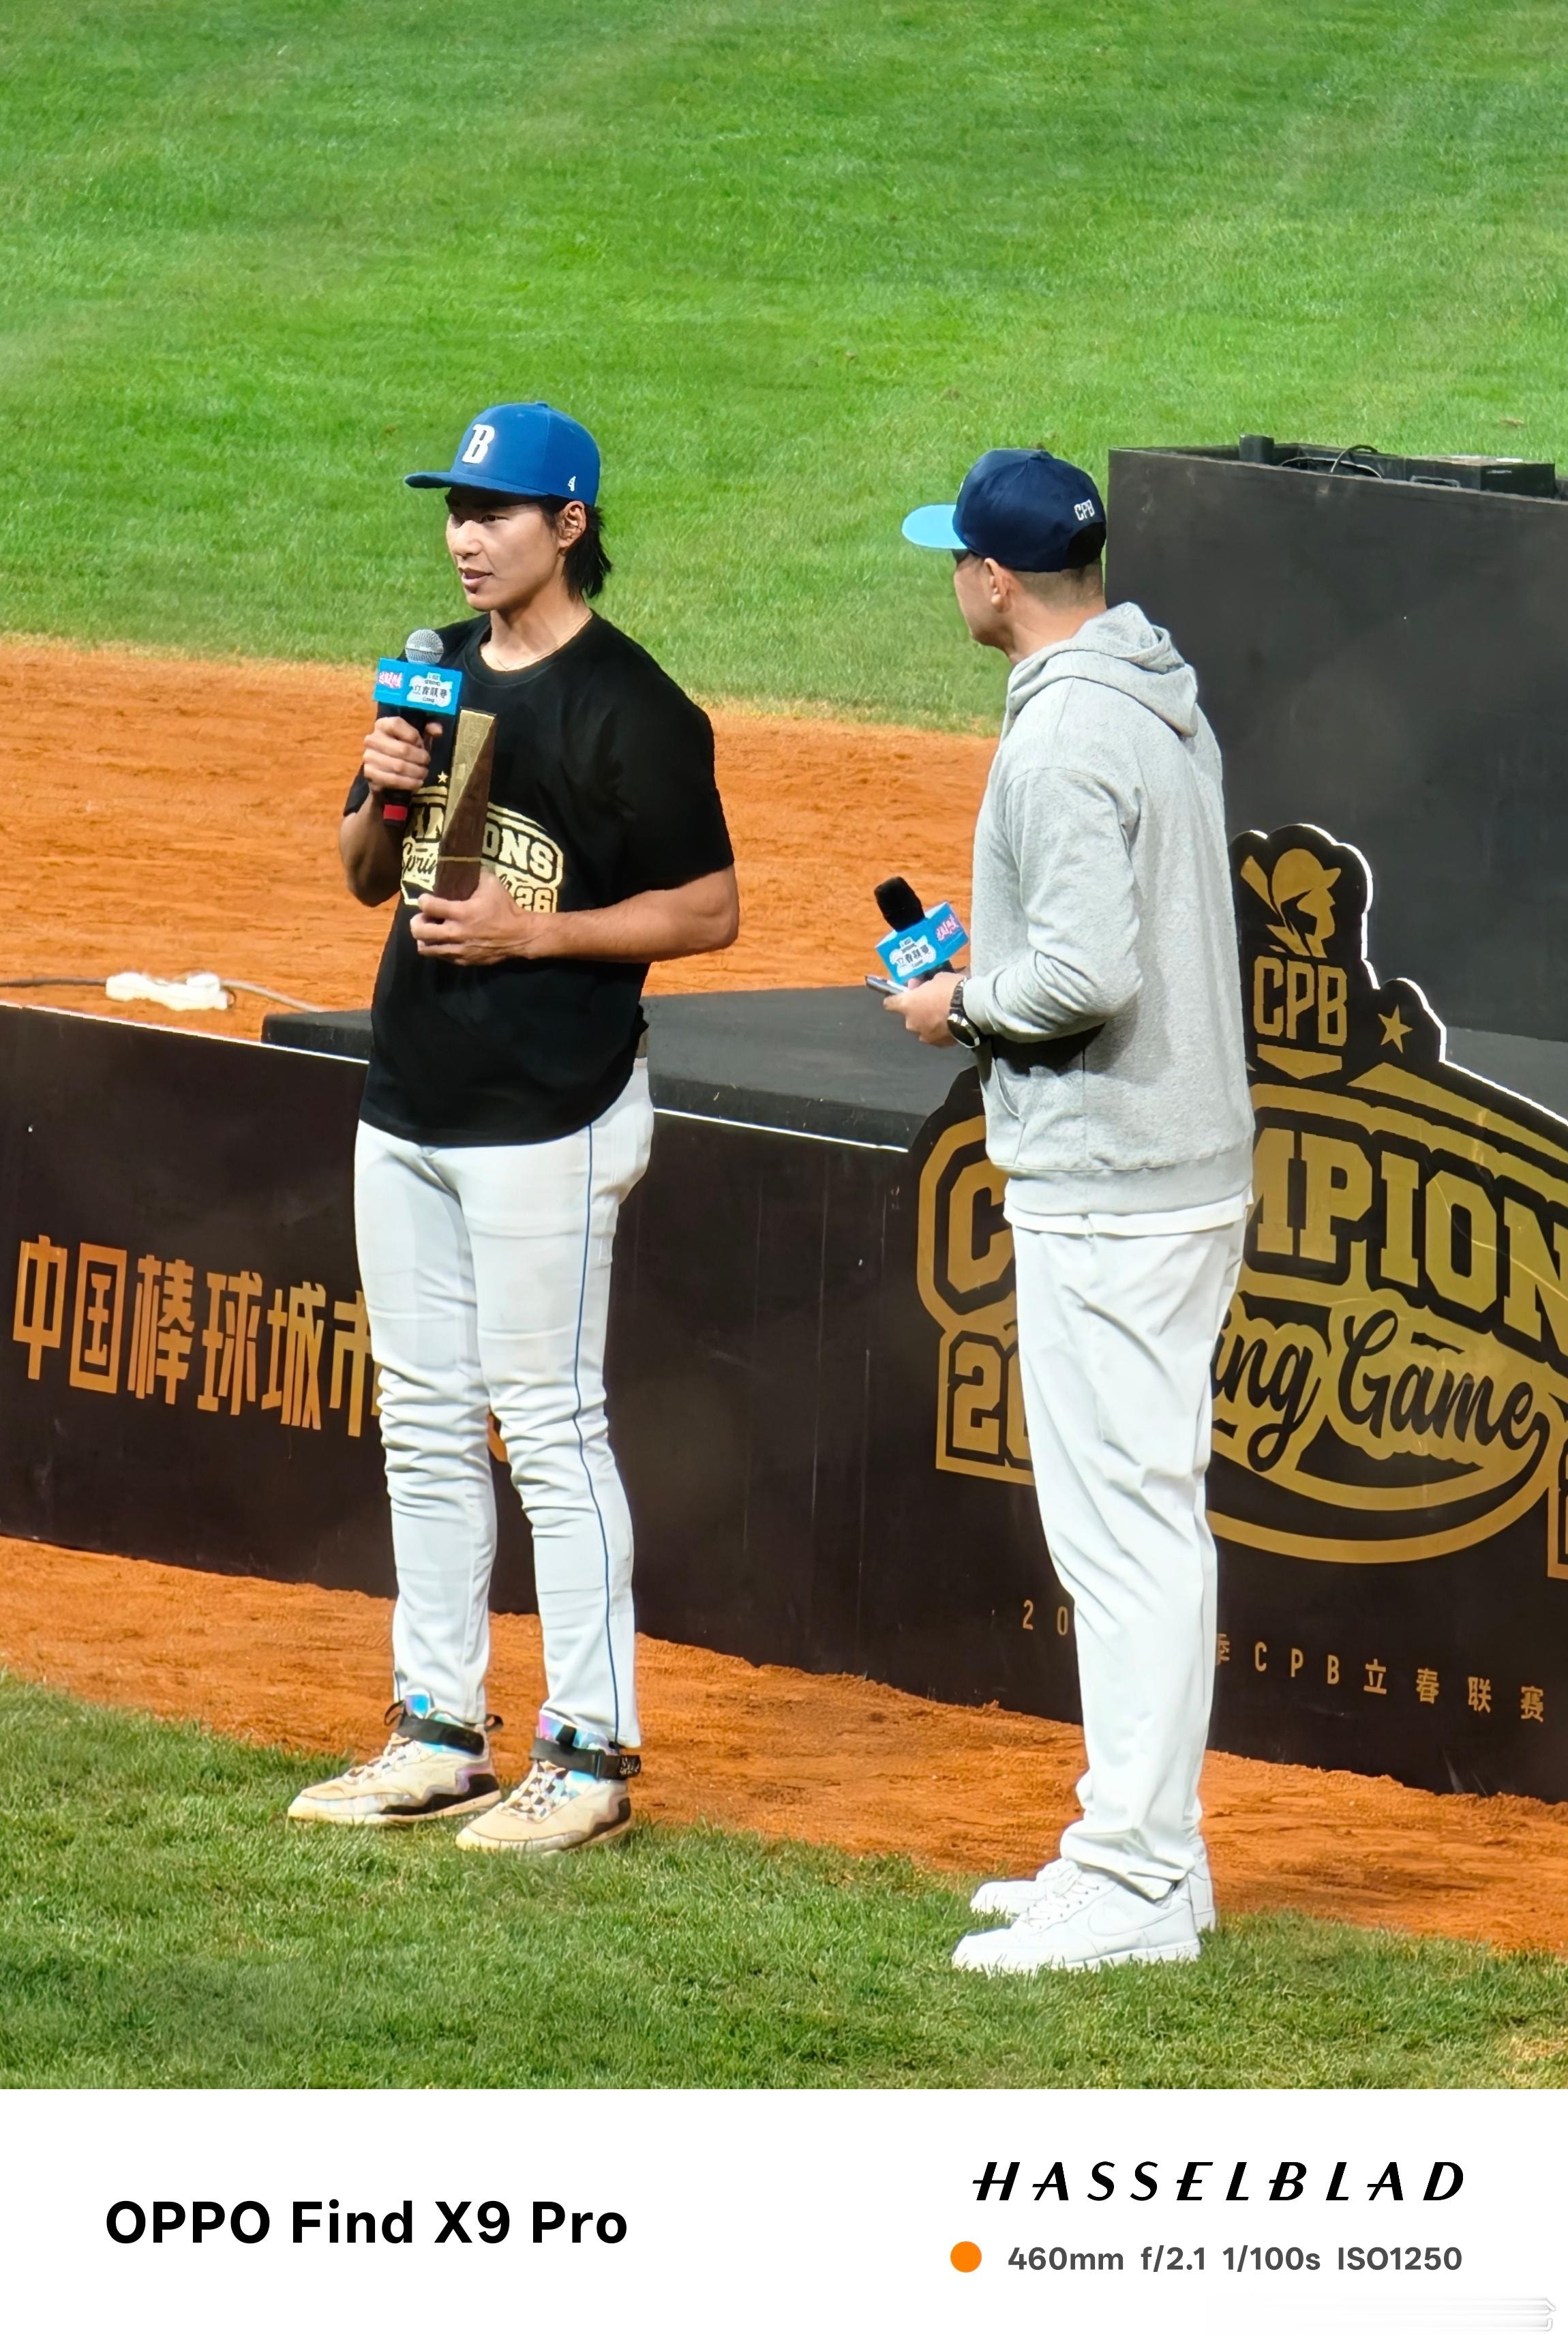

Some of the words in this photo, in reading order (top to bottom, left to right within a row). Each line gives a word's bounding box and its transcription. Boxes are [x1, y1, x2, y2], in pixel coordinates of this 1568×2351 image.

[462, 423, 496, 464] B
[1074, 499, 1096, 521] CPB
[1254, 957, 1348, 1047] CPB
[1210, 1308, 1321, 1473] ing
[1338, 1308, 1542, 1451] Game
